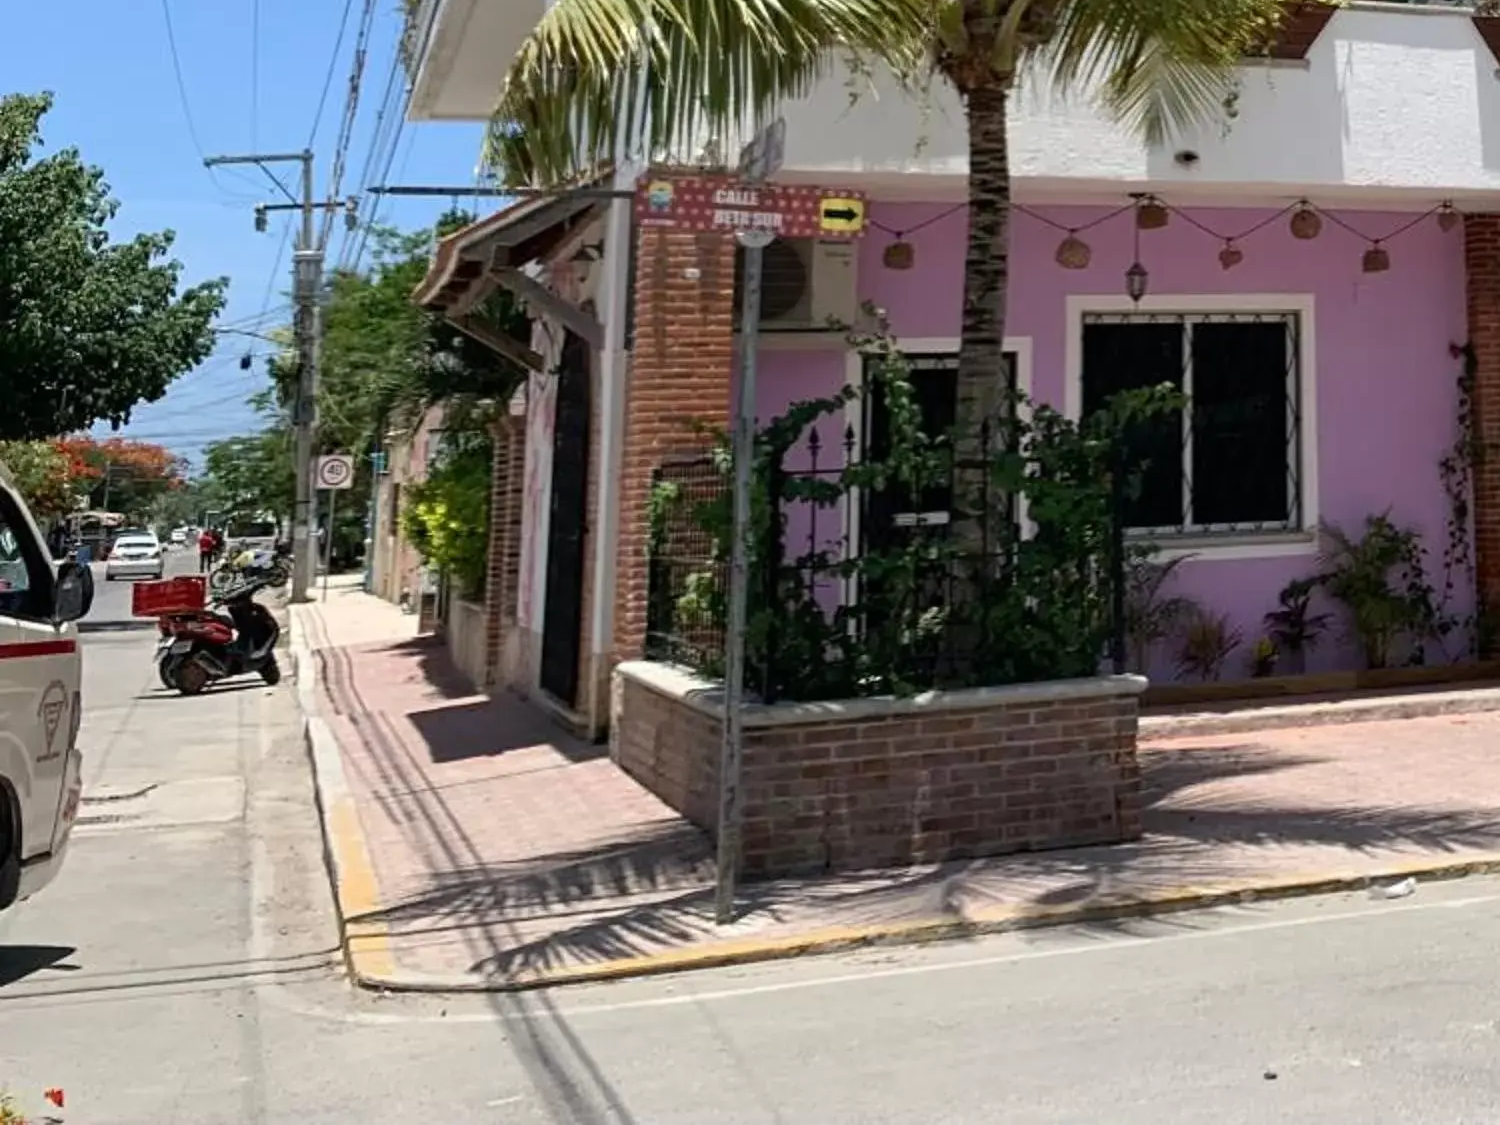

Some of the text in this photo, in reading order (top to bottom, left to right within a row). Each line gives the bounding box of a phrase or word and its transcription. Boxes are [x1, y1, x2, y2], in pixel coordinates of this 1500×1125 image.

[713, 189, 760, 206] CALLE
[753, 213, 783, 228] SUR
[327, 464, 343, 476] 40
